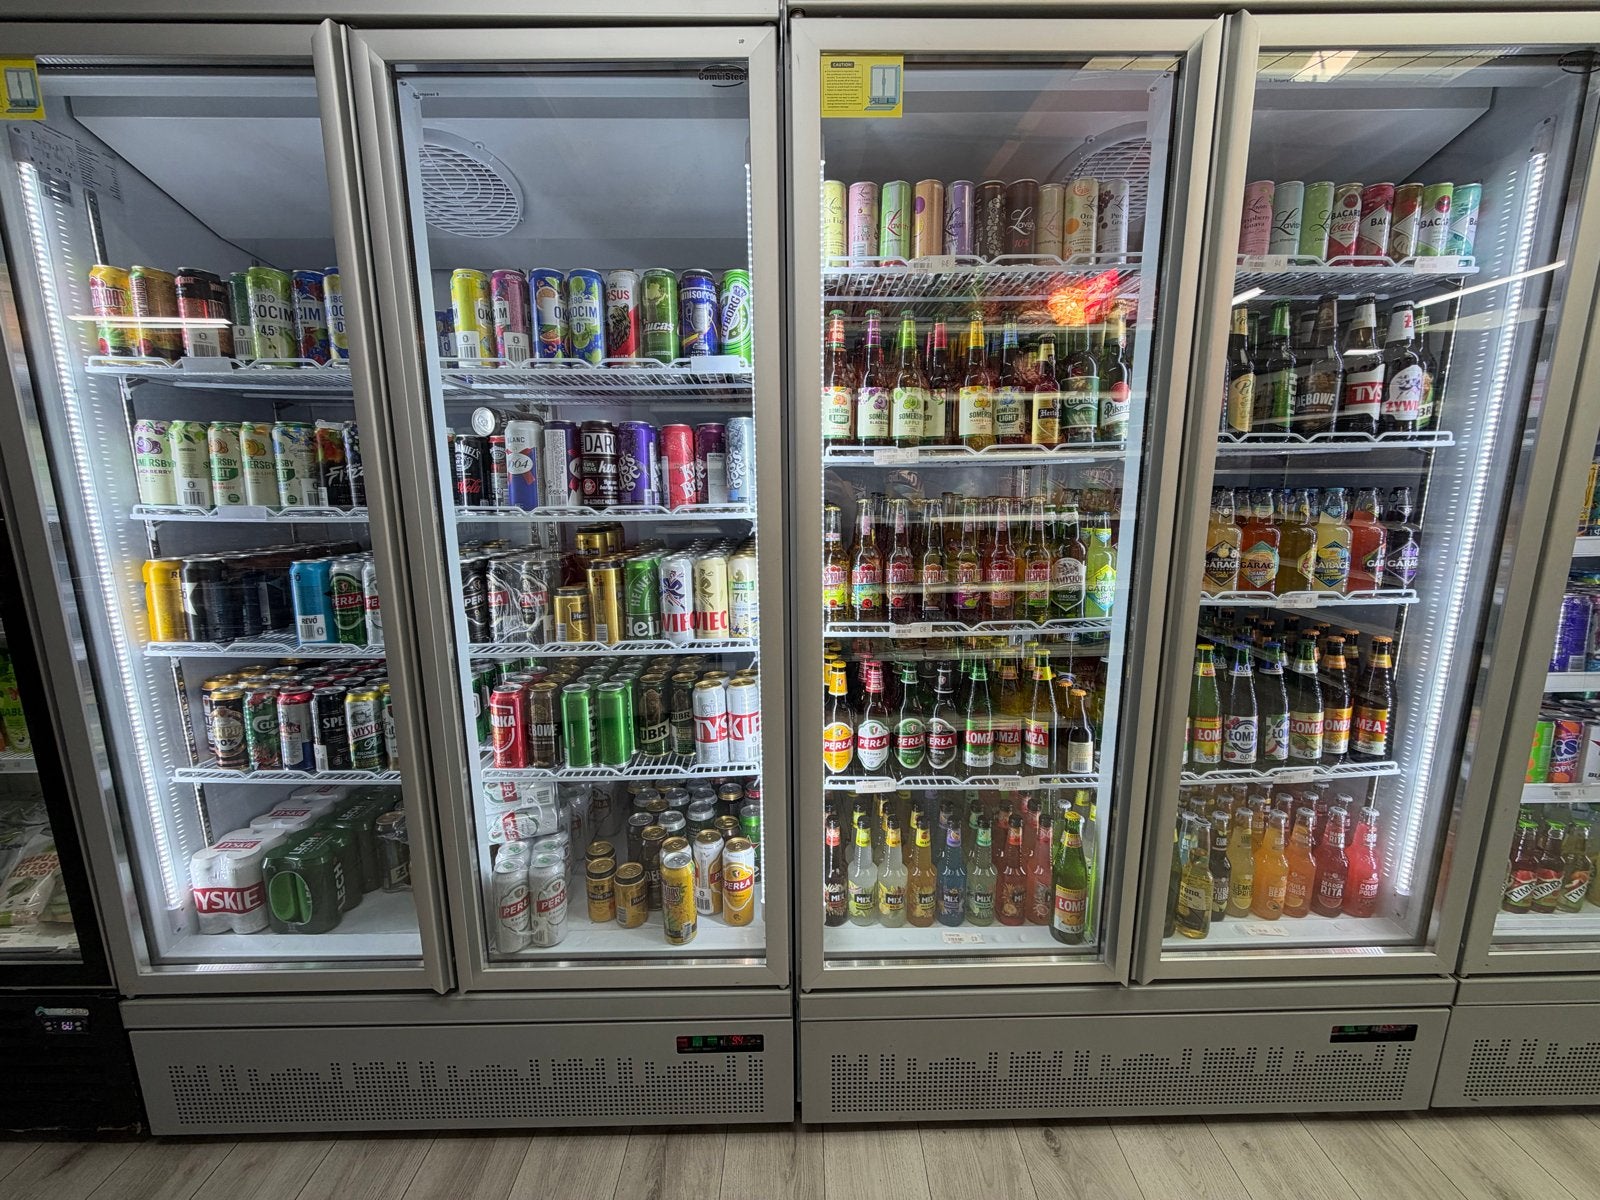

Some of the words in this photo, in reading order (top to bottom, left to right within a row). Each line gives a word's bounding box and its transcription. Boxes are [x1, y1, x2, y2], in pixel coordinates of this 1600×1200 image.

[698, 72, 747, 81] CombiSteel
[1005, 206, 1036, 236] Lavish
[721, 294, 742, 338] TUBORG
[998, 414, 1018, 422] LIGHT
[824, 739, 852, 751] PERŁA
[859, 737, 887, 747] PERŁA
[724, 880, 751, 892] PERŁA
[1320, 886, 1343, 897] RITA
[193, 886, 262, 911] TYSKIE
[856, 896, 872, 904] MIX
[887, 896, 903, 904] MIX
[944, 894, 959, 903] MIX
